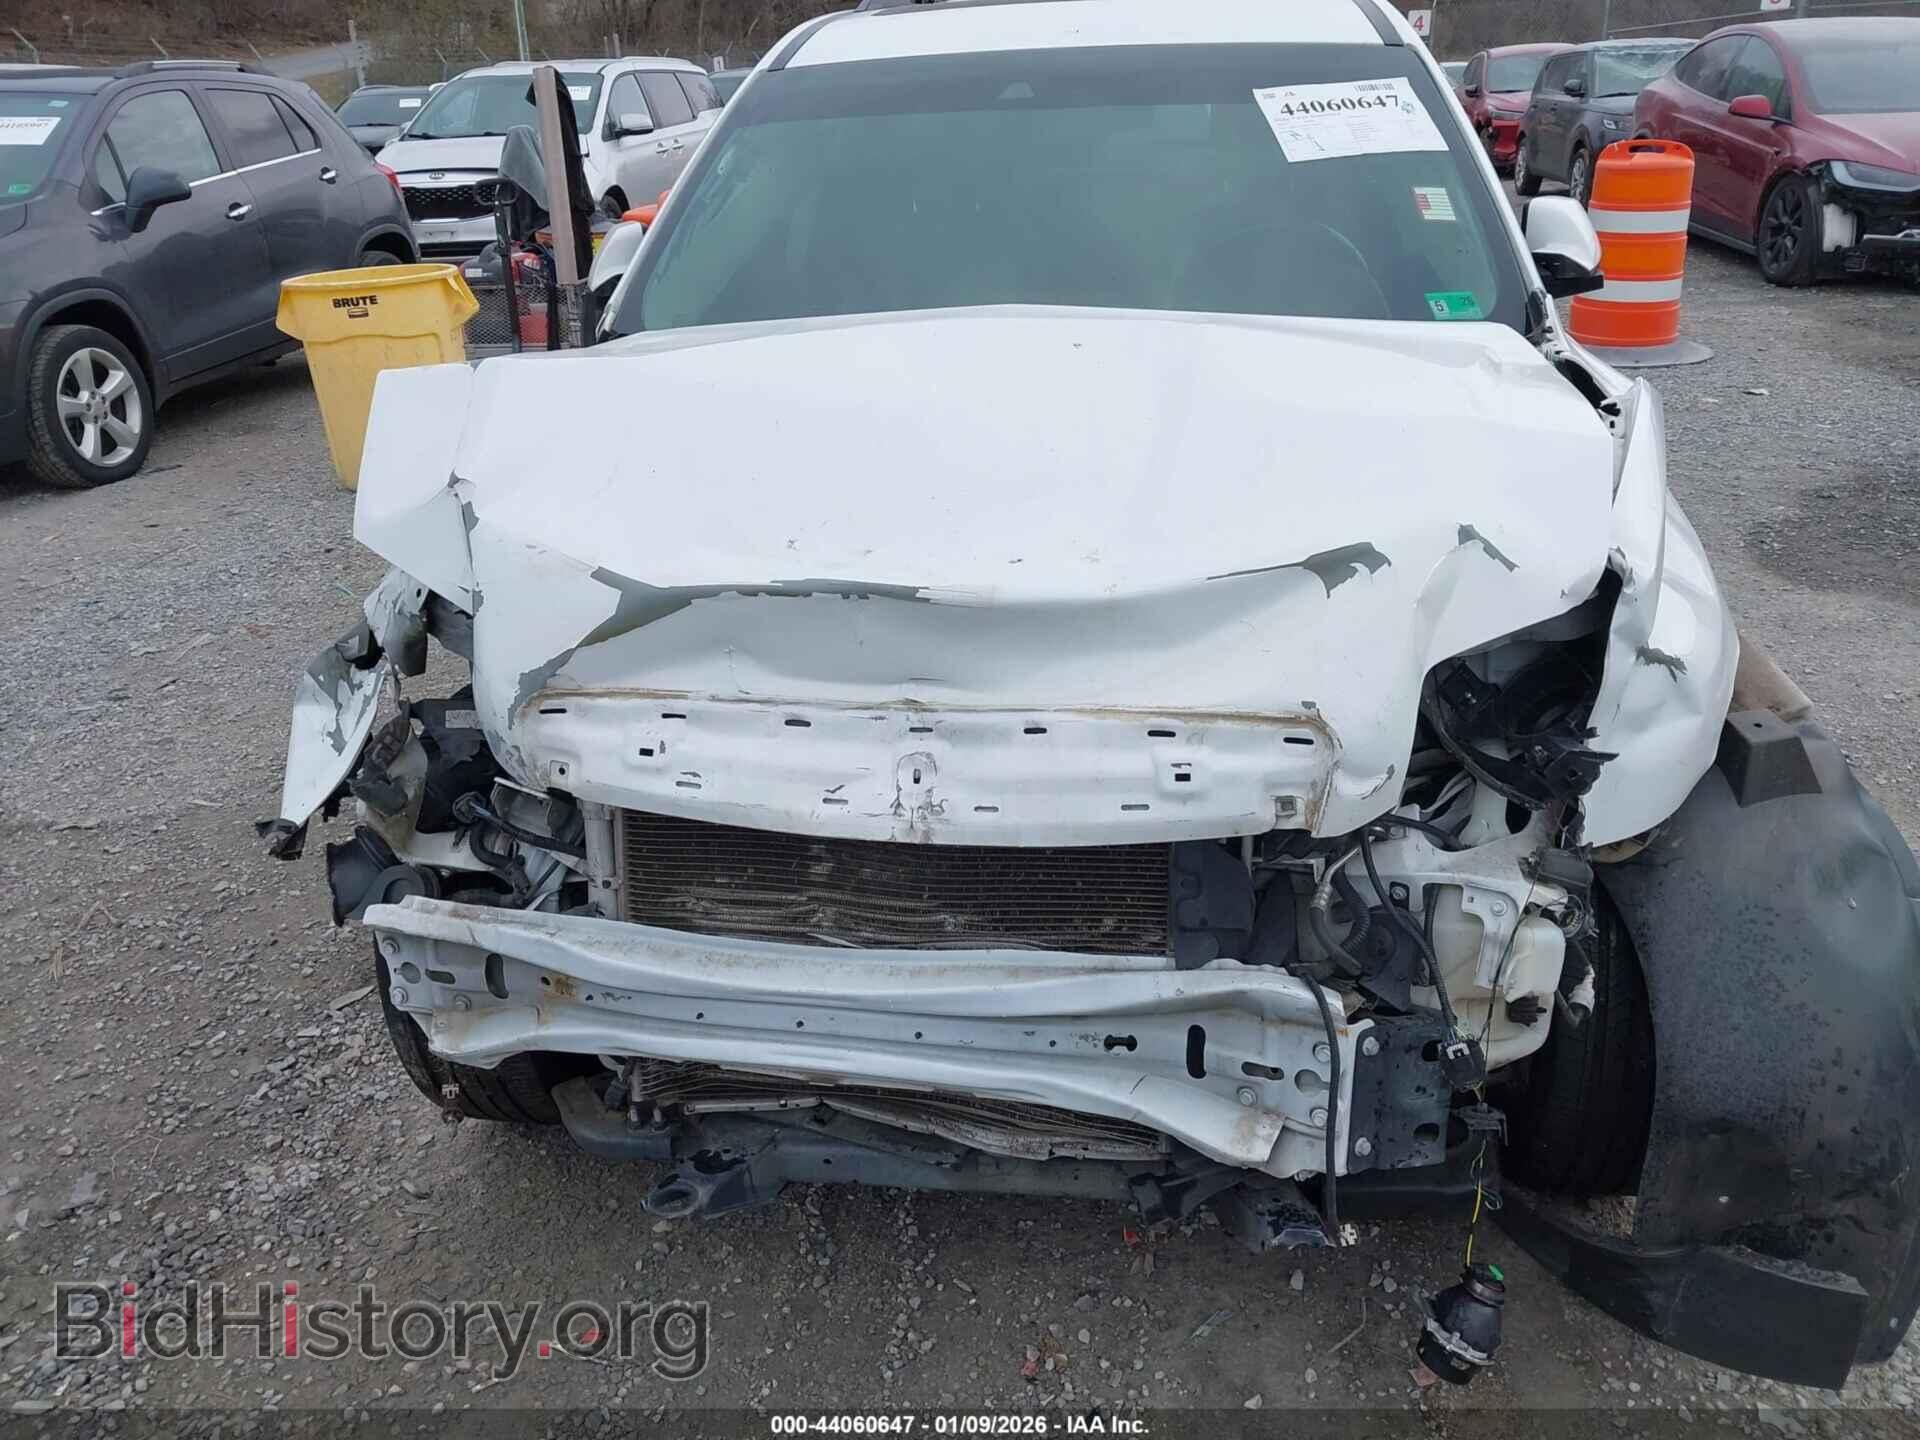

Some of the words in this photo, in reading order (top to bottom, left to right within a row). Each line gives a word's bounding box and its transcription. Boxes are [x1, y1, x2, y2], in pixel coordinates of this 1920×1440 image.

[1413, 15, 1425, 31] 4
[1280, 95, 1398, 116] 44060647
[332, 295, 379, 308] BRUTE
[1434, 300, 1444, 312] 5
